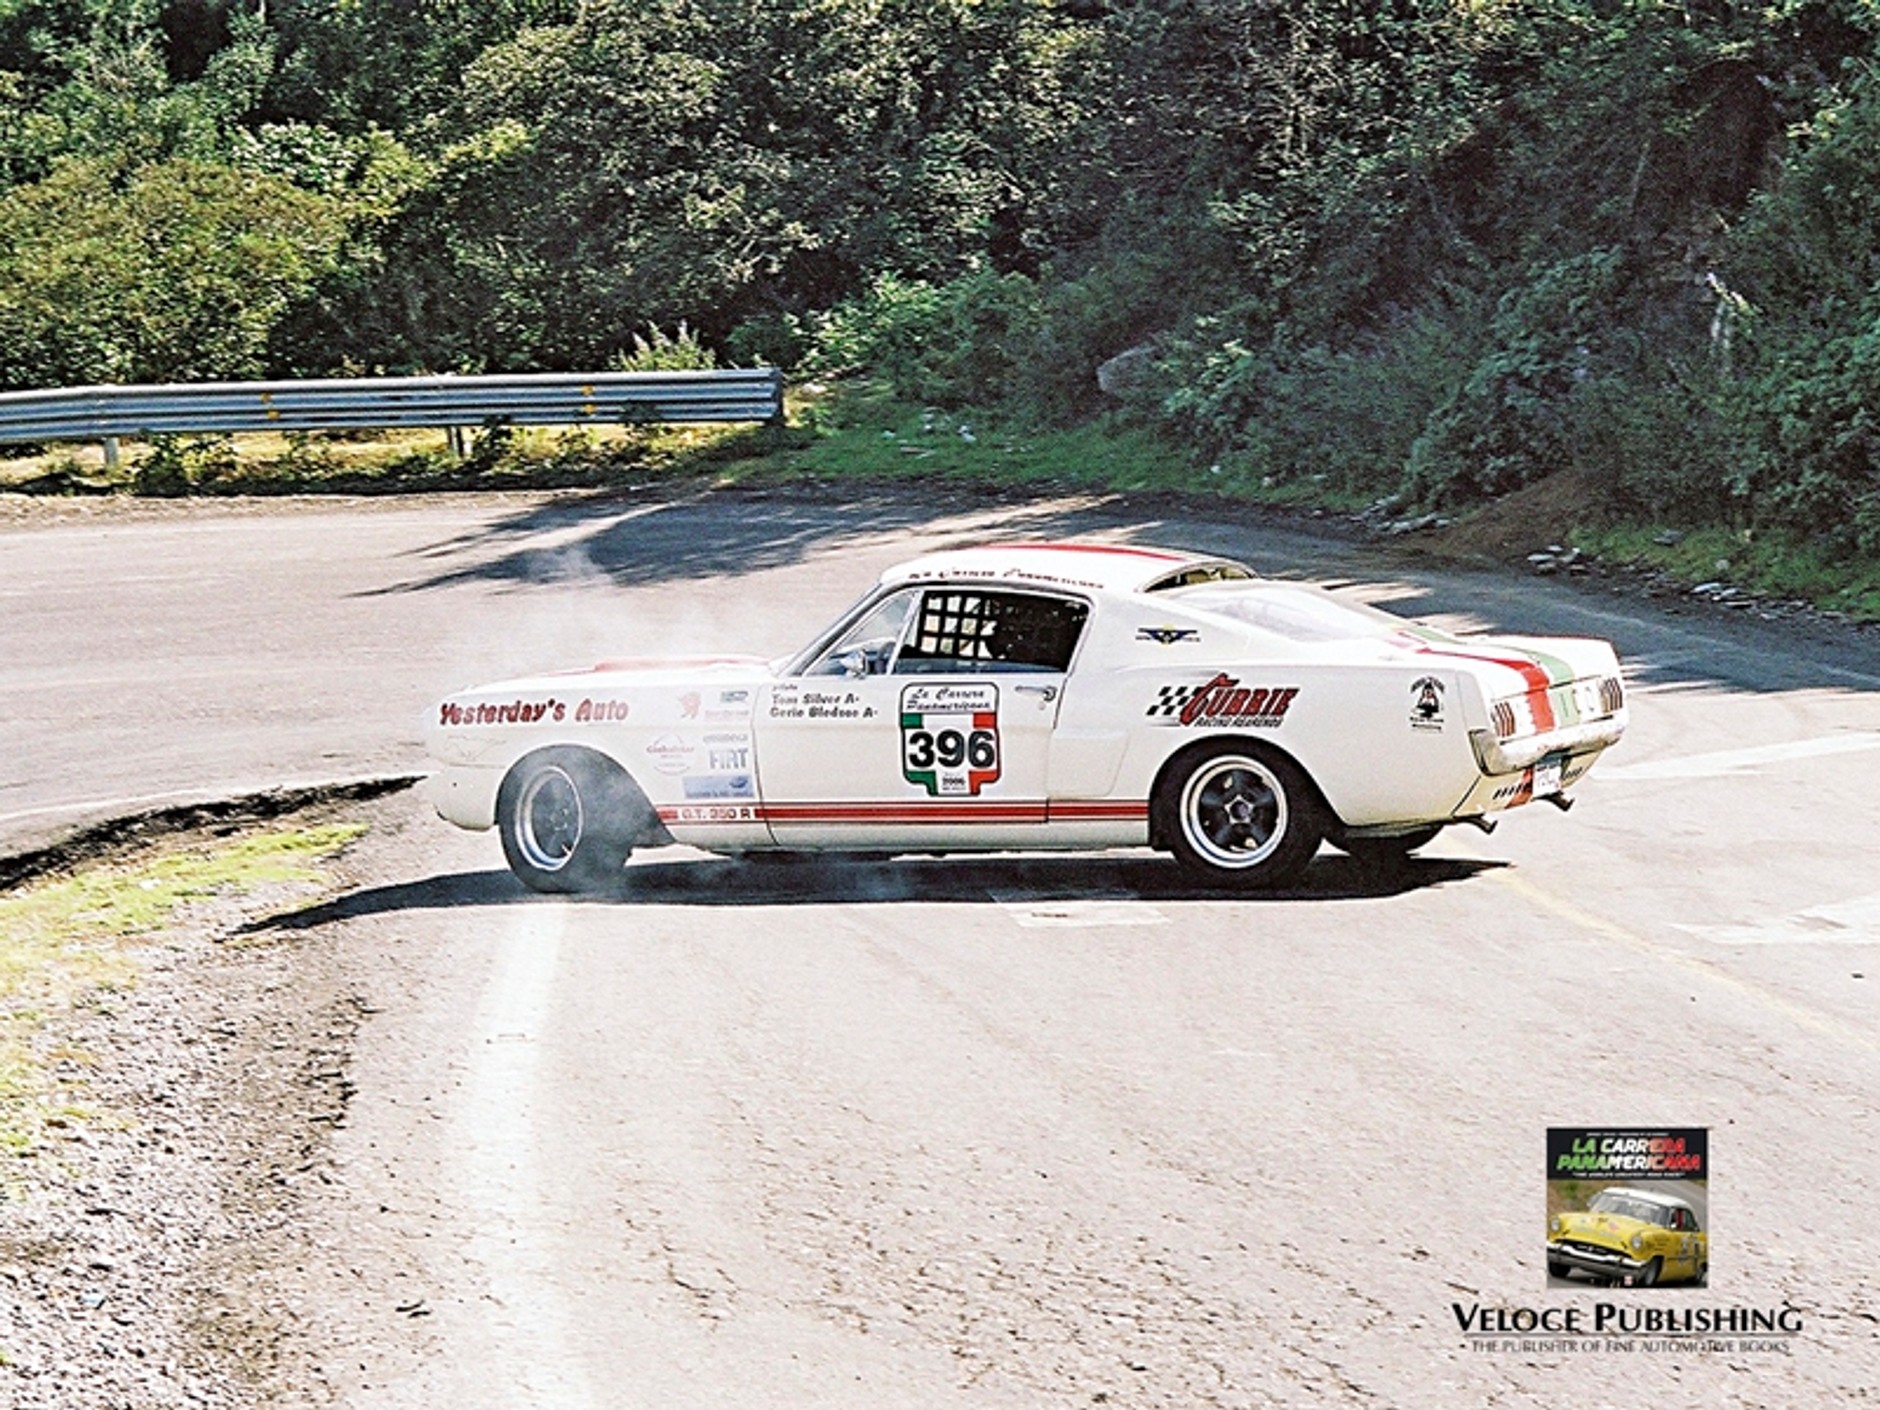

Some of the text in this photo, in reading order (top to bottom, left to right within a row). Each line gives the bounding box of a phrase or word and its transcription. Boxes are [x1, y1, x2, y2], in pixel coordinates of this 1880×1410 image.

[439, 698, 630, 725] Yesterday's Auto
[1179, 672, 1300, 726] CURRIE
[709, 748, 748, 769] FIAT
[909, 729, 995, 769] 396
